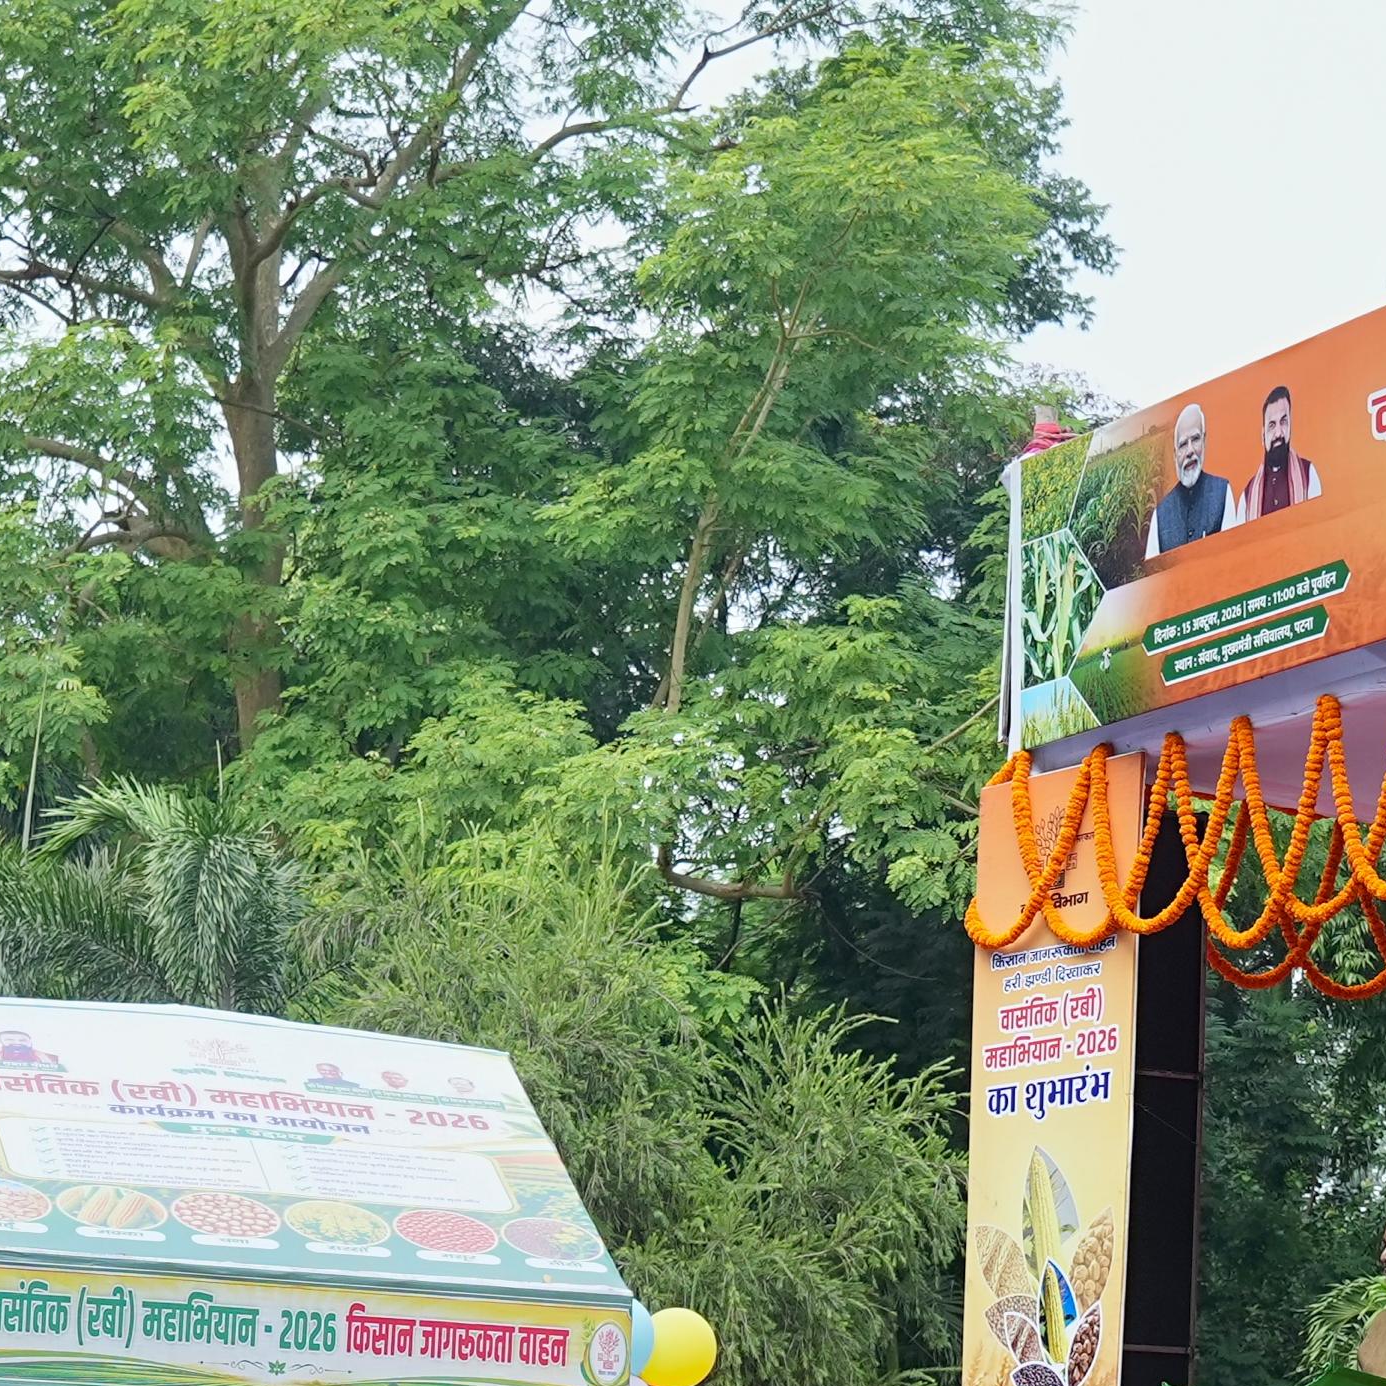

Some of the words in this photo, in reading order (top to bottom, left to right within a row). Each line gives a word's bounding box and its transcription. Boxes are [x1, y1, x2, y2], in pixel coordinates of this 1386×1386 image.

[1182, 618, 1192, 637] 15
[1221, 603, 1242, 623] 2026
[1272, 586, 1296, 610] 11:00
[1295, 577, 1311, 597] बजे
[1293, 617, 1315, 638] पटना
[1050, 891, 1089, 909] विभाग
[991, 953, 1027, 970] किसान
[1003, 972, 1022, 992] हरी
[1055, 962, 1102, 983] दिखाकर
[999, 998, 1060, 1032] वासंतिक
[1063, 987, 1105, 1028] (रबी)
[984, 1034, 1062, 1073] महाभियान
[1076, 1025, 1118, 1060] 2026
[111, 1079, 198, 1107] (रबी)
[204, 1088, 376, 1121] महाभियान
[405, 1108, 490, 1132] 2026
[987, 1084, 1017, 1117] का
[1025, 1063, 1112, 1121] शुभारंभ
[109, 1102, 214, 1121] कार्यक्रम
[222, 1109, 257, 1124] का
[266, 1113, 370, 1136] आयोजन
[75, 1285, 136, 1348] (रबी)
[140, 1291, 259, 1349] महाभियान
[279, 1309, 338, 1353] 2026
[345, 1302, 417, 1358] किसान
[517, 1326, 570, 1367] वाहन
